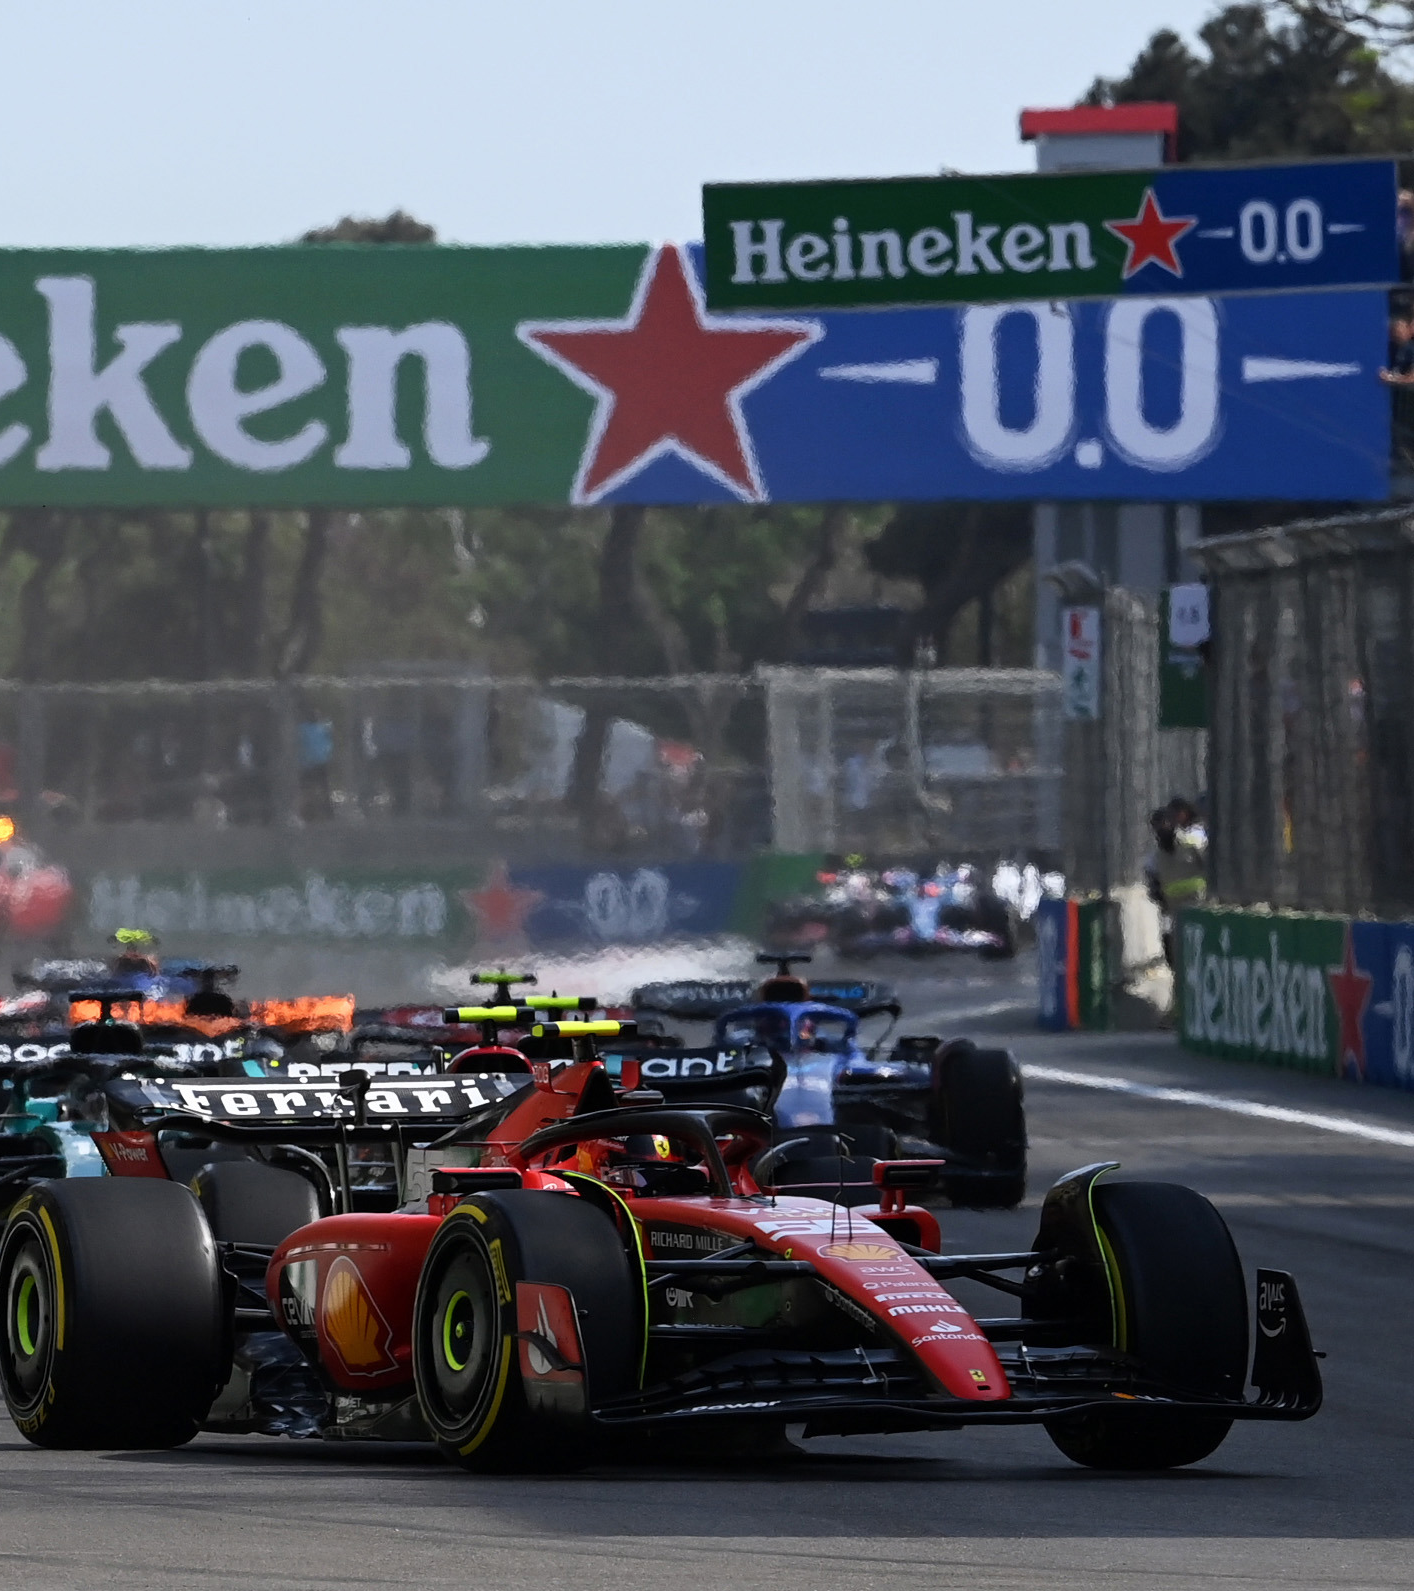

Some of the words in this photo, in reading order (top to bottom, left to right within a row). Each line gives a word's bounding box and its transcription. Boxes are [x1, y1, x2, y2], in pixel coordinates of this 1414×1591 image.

[728, 212, 1096, 285] Heineken
[1239, 199, 1324, 264] 0.0
[959, 296, 1223, 473] 0.0
[1184, 922, 1329, 1060] Heineken
[172, 1079, 487, 1117] Ferrari
[108, 1142, 149, 1162] V-Power
[651, 1231, 693, 1249] RICHARD
[695, 1235, 723, 1251] MILLE
[859, 1264, 913, 1273] aws
